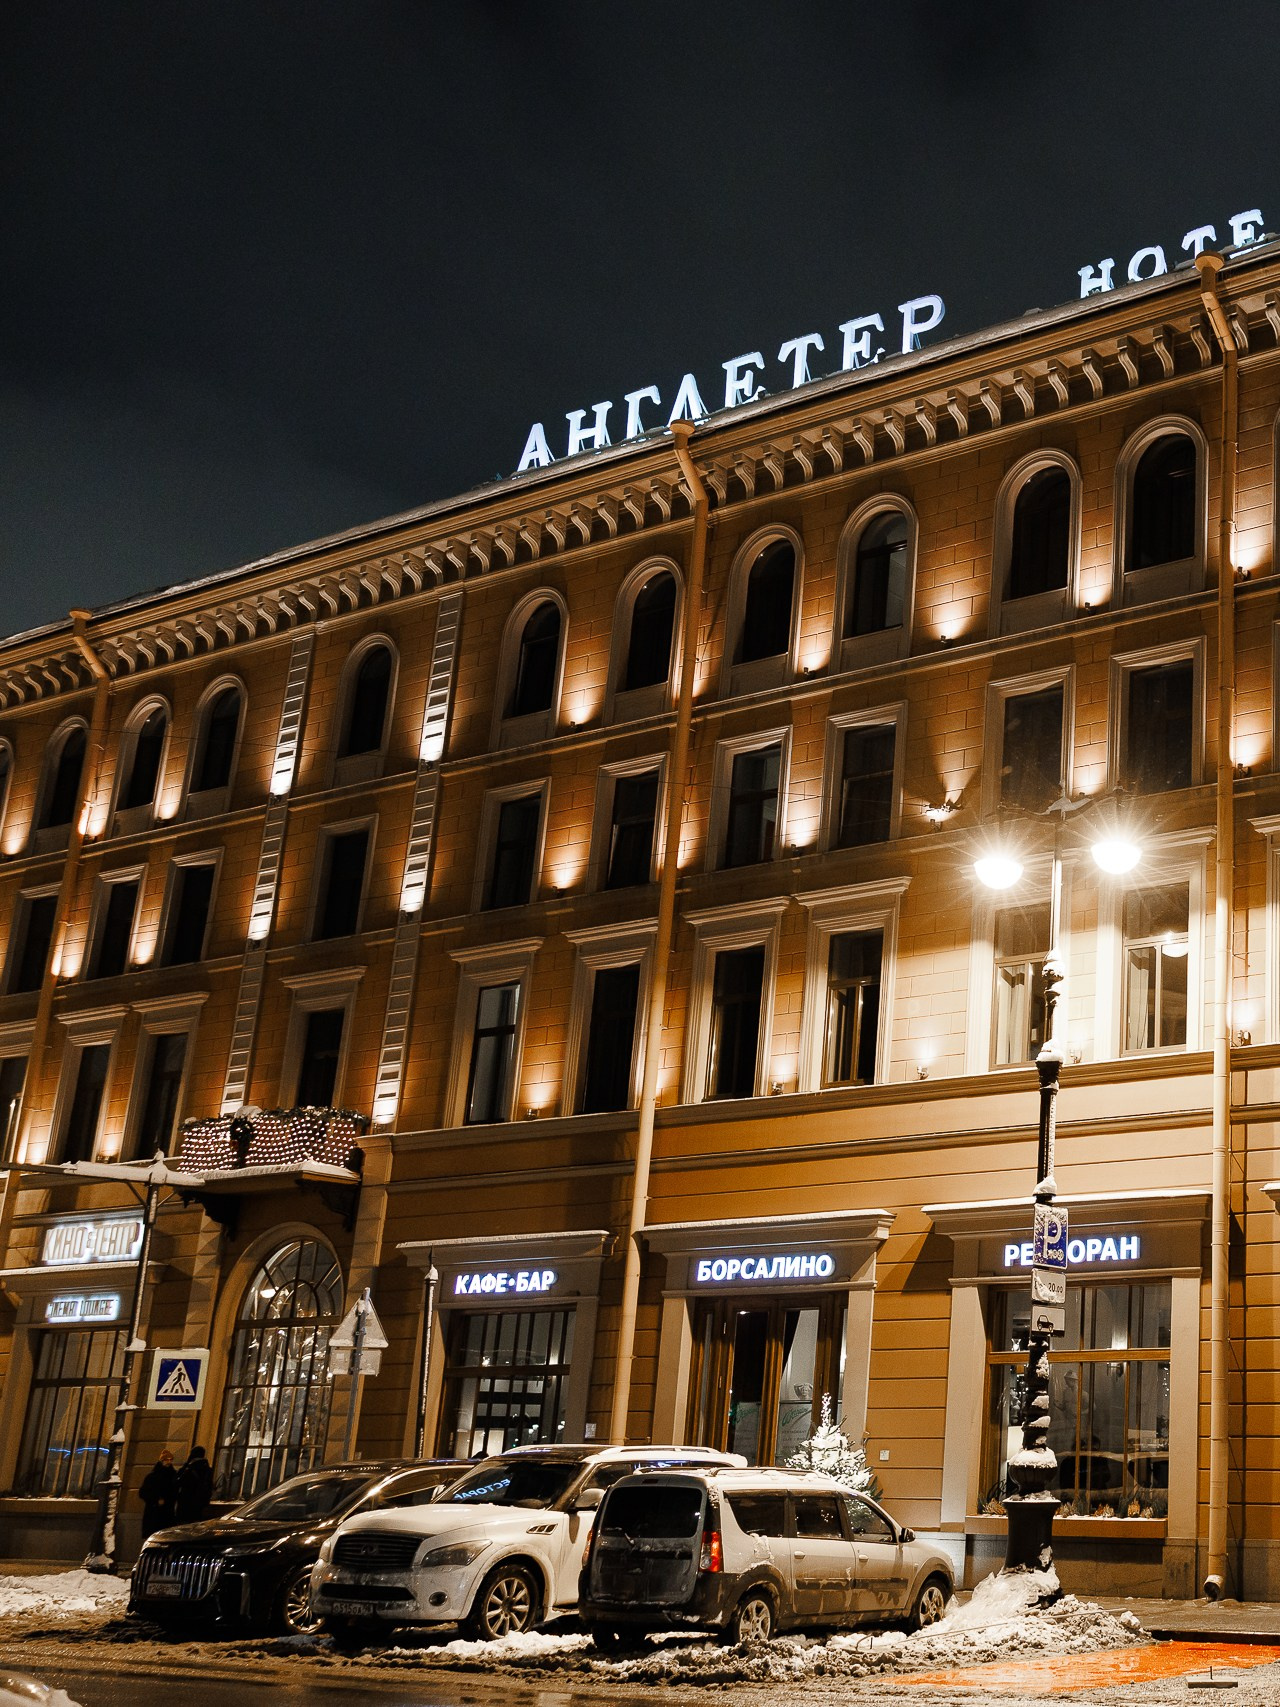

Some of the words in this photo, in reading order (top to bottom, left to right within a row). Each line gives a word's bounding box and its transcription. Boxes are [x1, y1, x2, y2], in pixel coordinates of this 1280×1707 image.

[516, 294, 946, 472] АНГЛЕТЕР
[1004, 1235, 1141, 1267] РЕОРАН
[697, 1253, 835, 1282] БОРСАЛИНО
